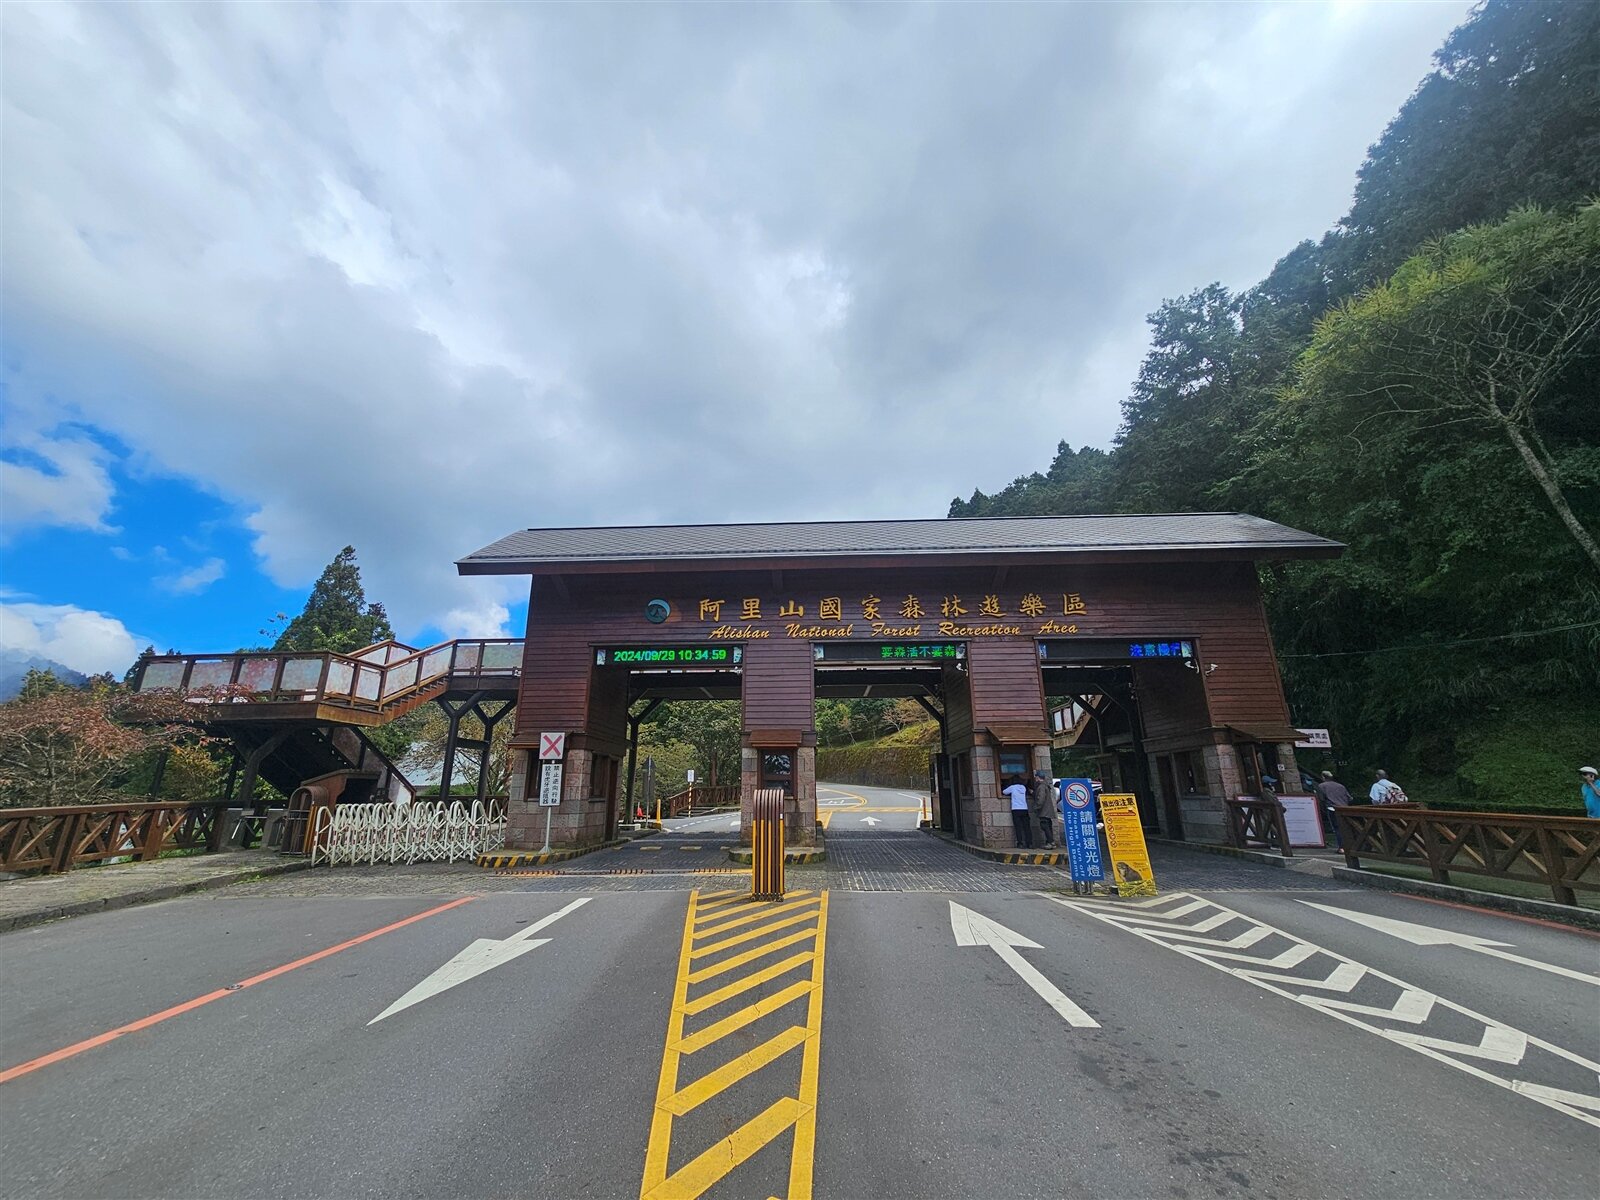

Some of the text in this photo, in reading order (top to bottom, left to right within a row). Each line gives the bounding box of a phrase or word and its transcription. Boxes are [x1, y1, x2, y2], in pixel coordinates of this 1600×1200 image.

[698, 593, 1088, 622] 阿里山國家森林遊樂區
[708, 619, 1079, 640] Alishan National Forest Recreation Area
[613, 650, 675, 662] 2024/09/29
[1079, 811, 1101, 877] 請關遠光燈
